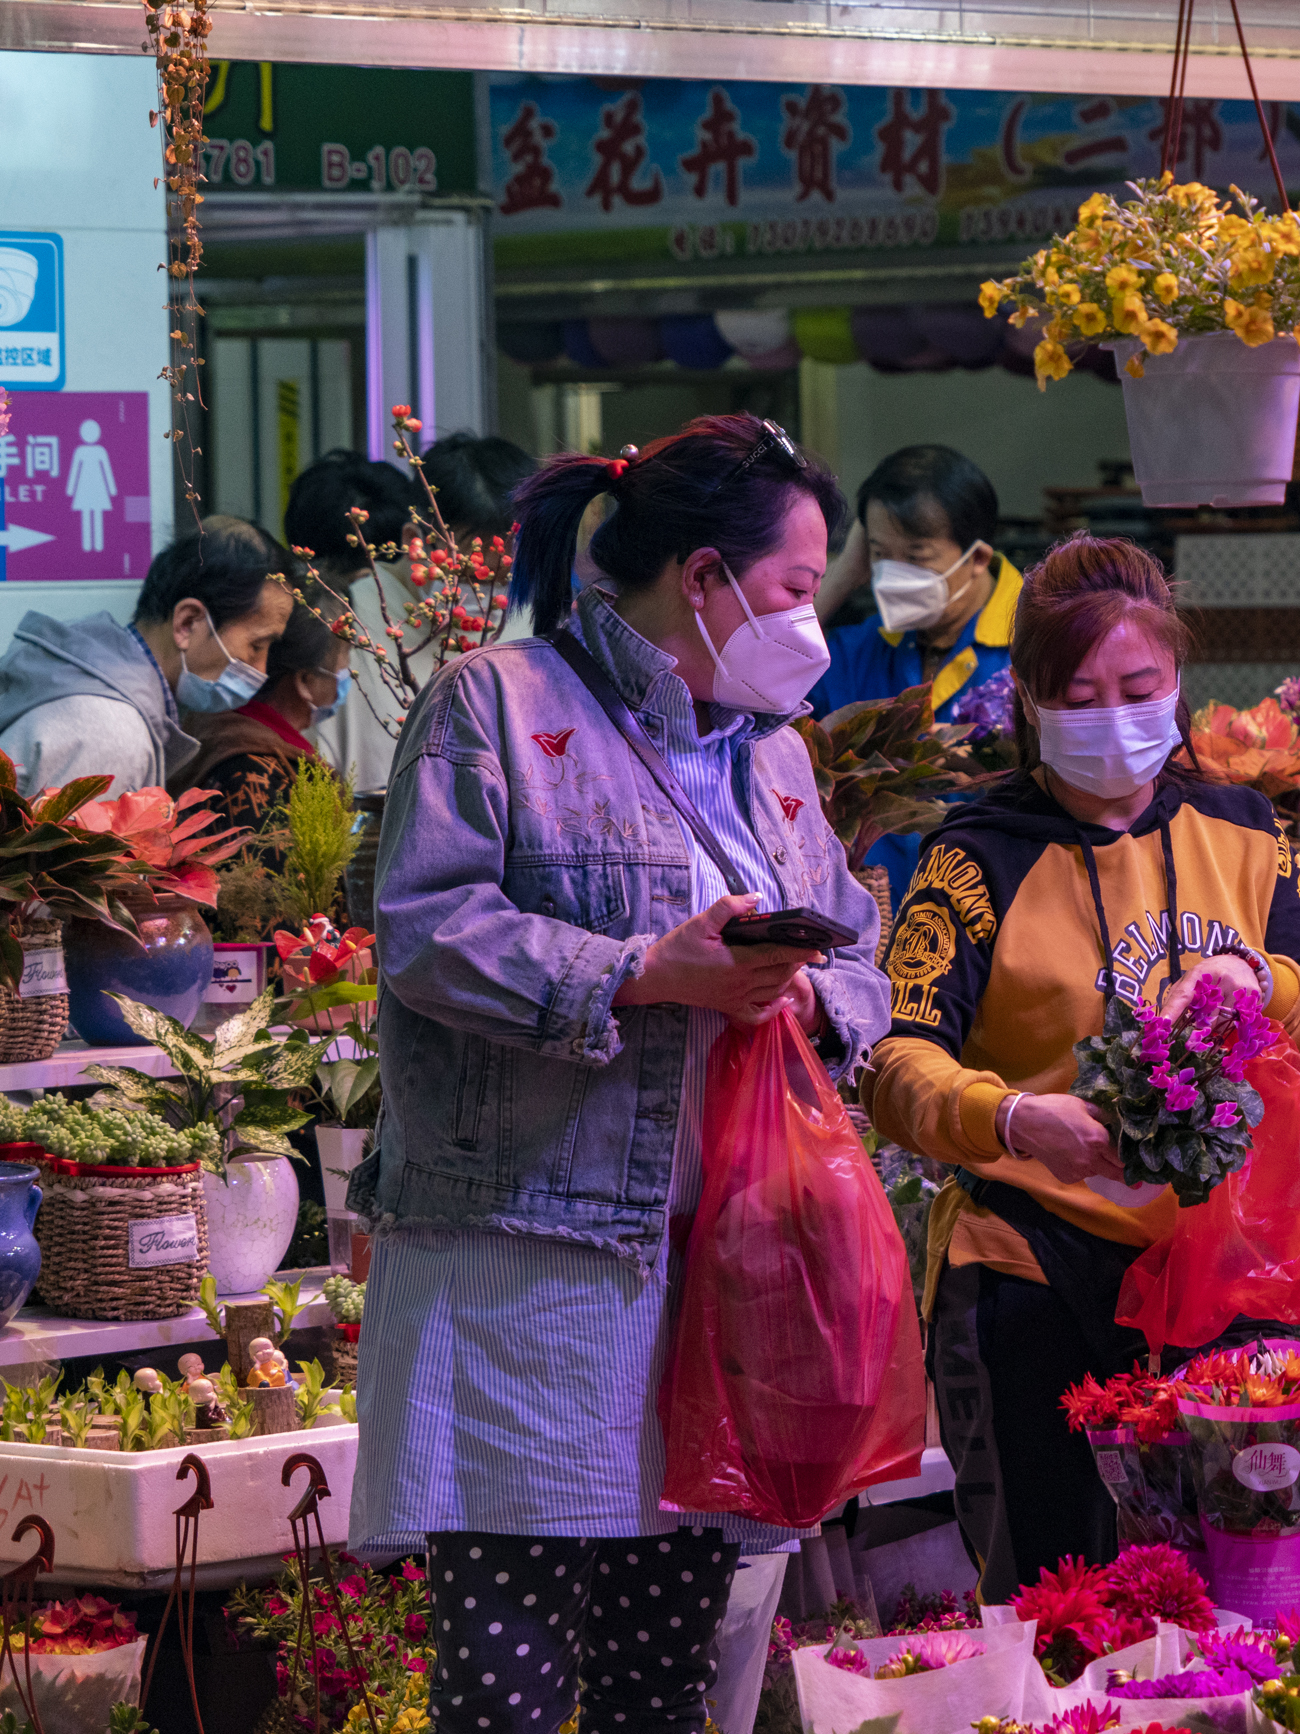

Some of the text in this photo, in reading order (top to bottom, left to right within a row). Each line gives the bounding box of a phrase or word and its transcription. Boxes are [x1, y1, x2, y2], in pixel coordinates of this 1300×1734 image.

[193, 138, 438, 191] 781 B-102
[0, 347, 52, 367] 控区域
[741, 443, 768, 468] GUCCI
[1095, 908, 1247, 1006] BELMON
[1243, 1449, 1289, 1478] 仙舞
